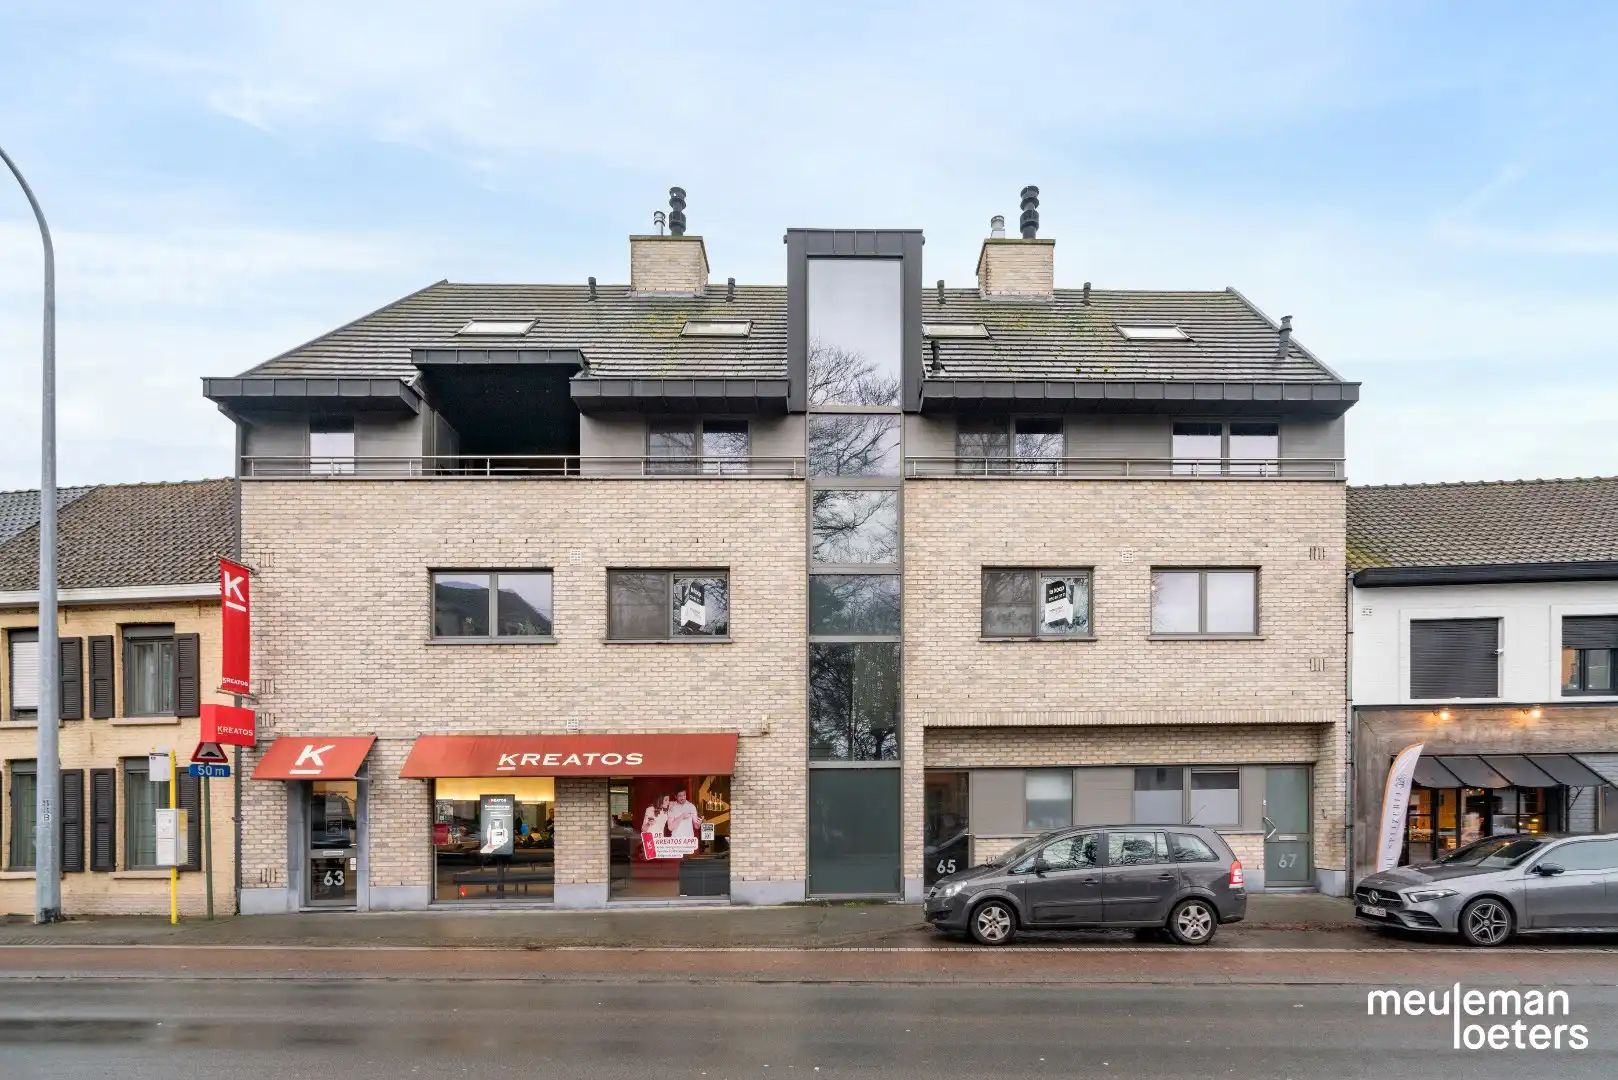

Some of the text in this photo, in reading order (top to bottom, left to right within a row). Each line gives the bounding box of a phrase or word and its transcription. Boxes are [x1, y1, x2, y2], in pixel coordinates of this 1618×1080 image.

[224, 571, 246, 602] K
[222, 677, 249, 687] KREATOS
[217, 725, 254, 737] KREATOS
[294, 744, 336, 767] K
[497, 752, 643, 768] KREATOS
[197, 765, 225, 776] 50 m
[936, 859, 956, 874] 65
[1277, 853, 1298, 869] 67
[323, 870, 345, 886] 63
